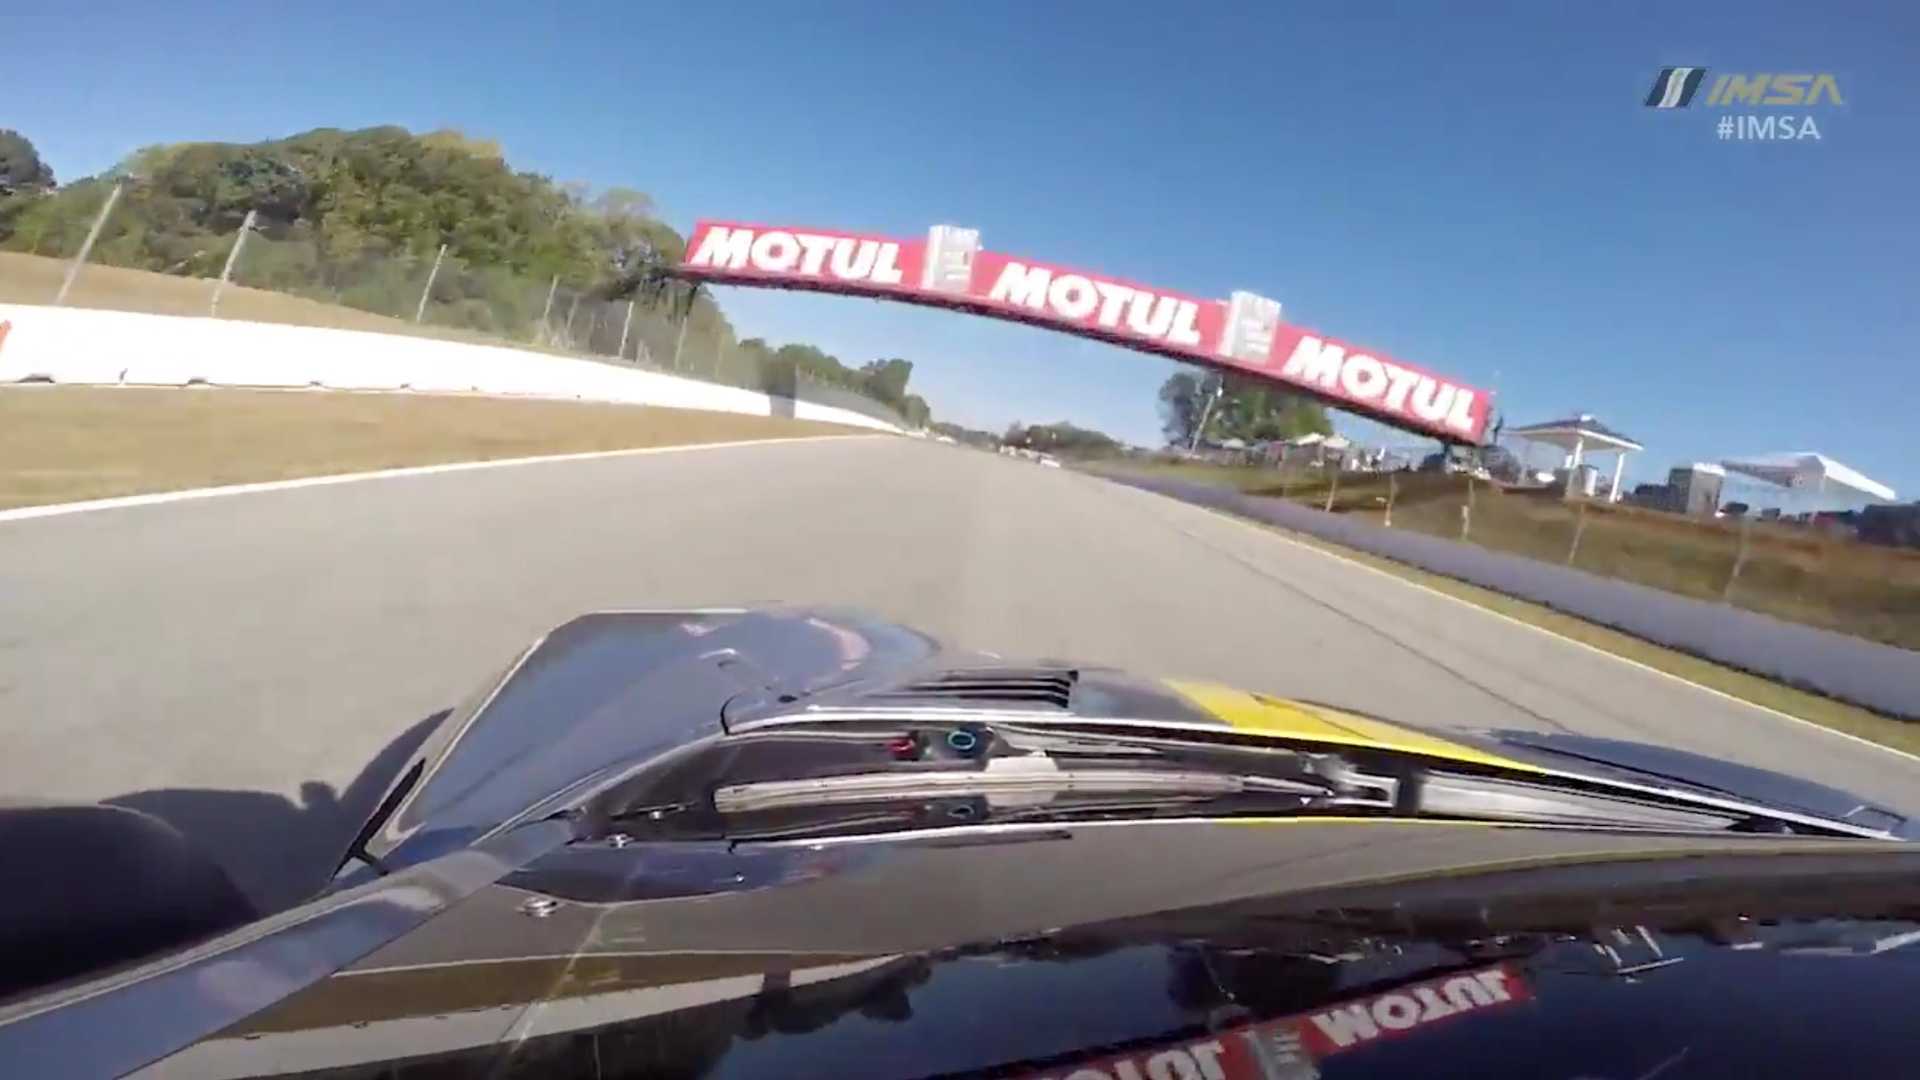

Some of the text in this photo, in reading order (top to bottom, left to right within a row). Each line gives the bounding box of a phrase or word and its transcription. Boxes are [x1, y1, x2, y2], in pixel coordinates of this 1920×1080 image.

[690, 226, 904, 285] MOTUL
[987, 262, 1201, 347] MOTUL
[1282, 334, 1477, 433] MOTUL
